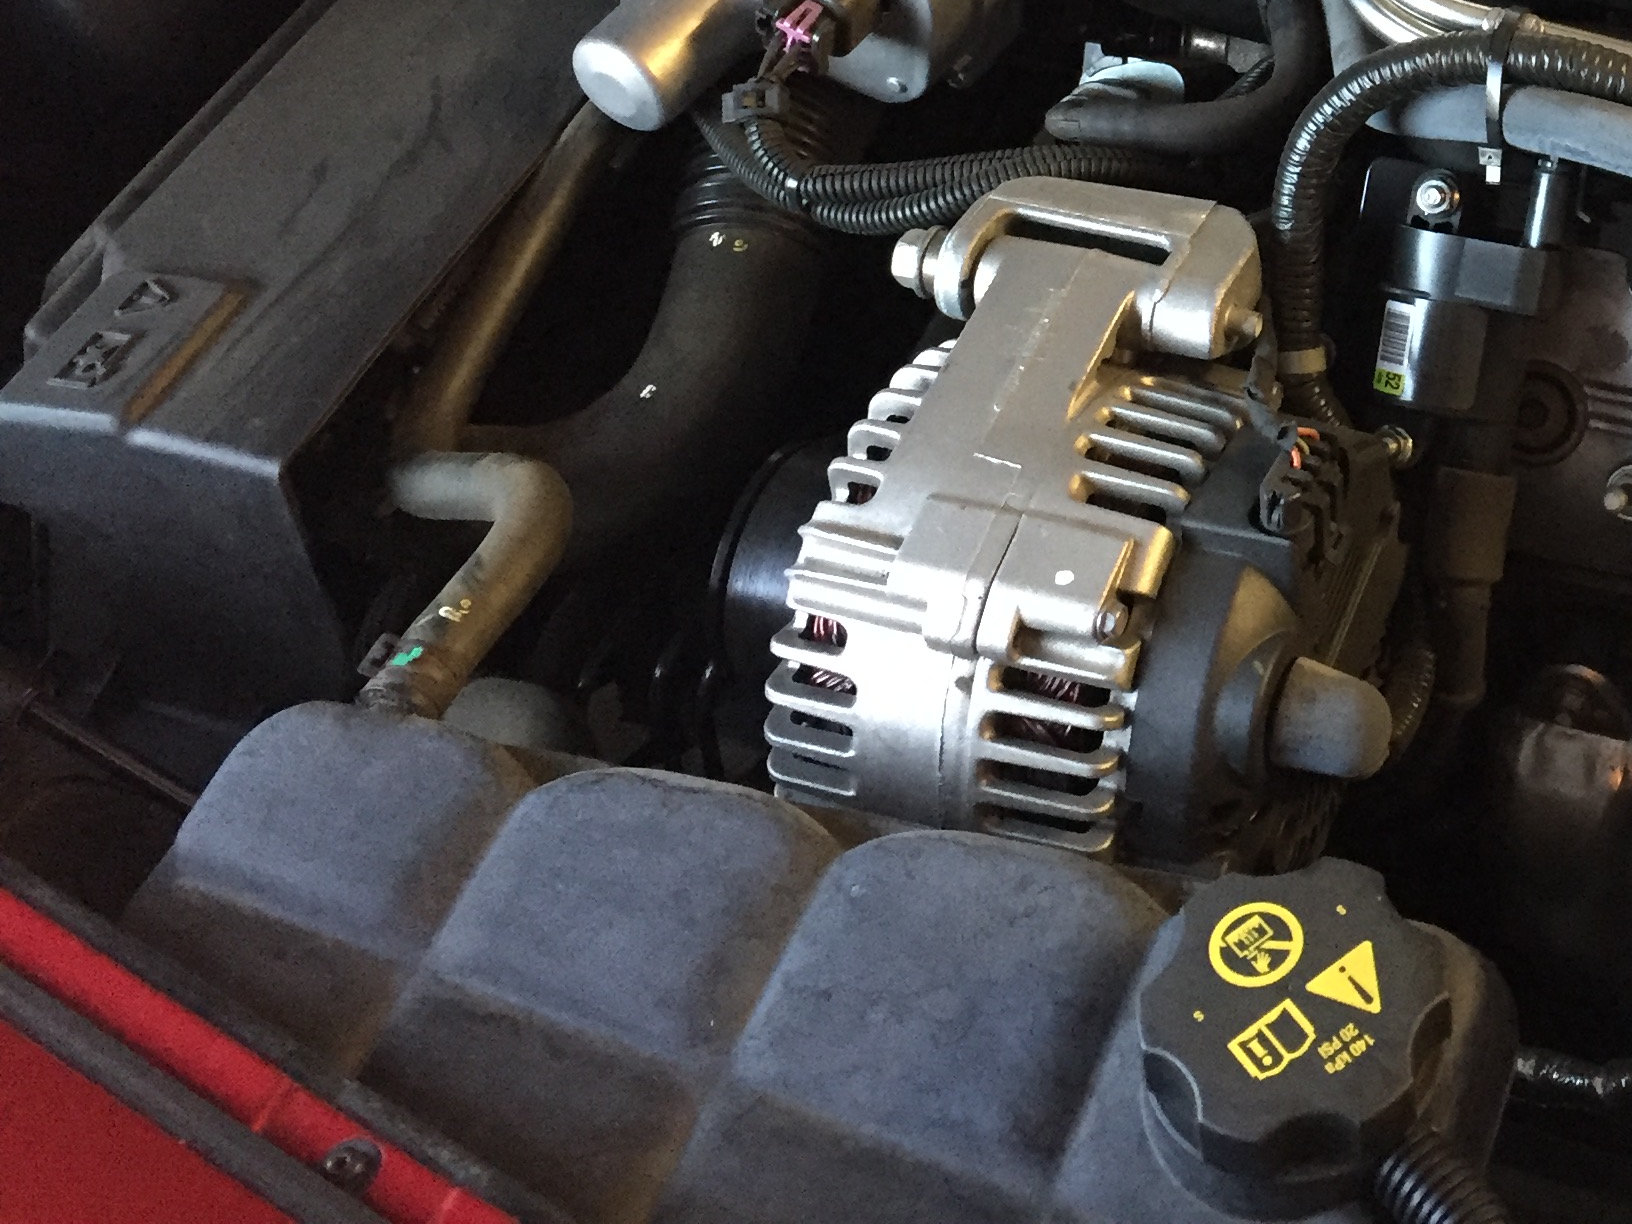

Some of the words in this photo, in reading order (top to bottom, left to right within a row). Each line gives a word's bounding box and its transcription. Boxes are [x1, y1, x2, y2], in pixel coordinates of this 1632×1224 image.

[1384, 371, 1402, 391] 52
[1339, 1022, 1359, 1042] 20
[1317, 1035, 1343, 1059] PSI
[1349, 1034, 1375, 1056] 140
